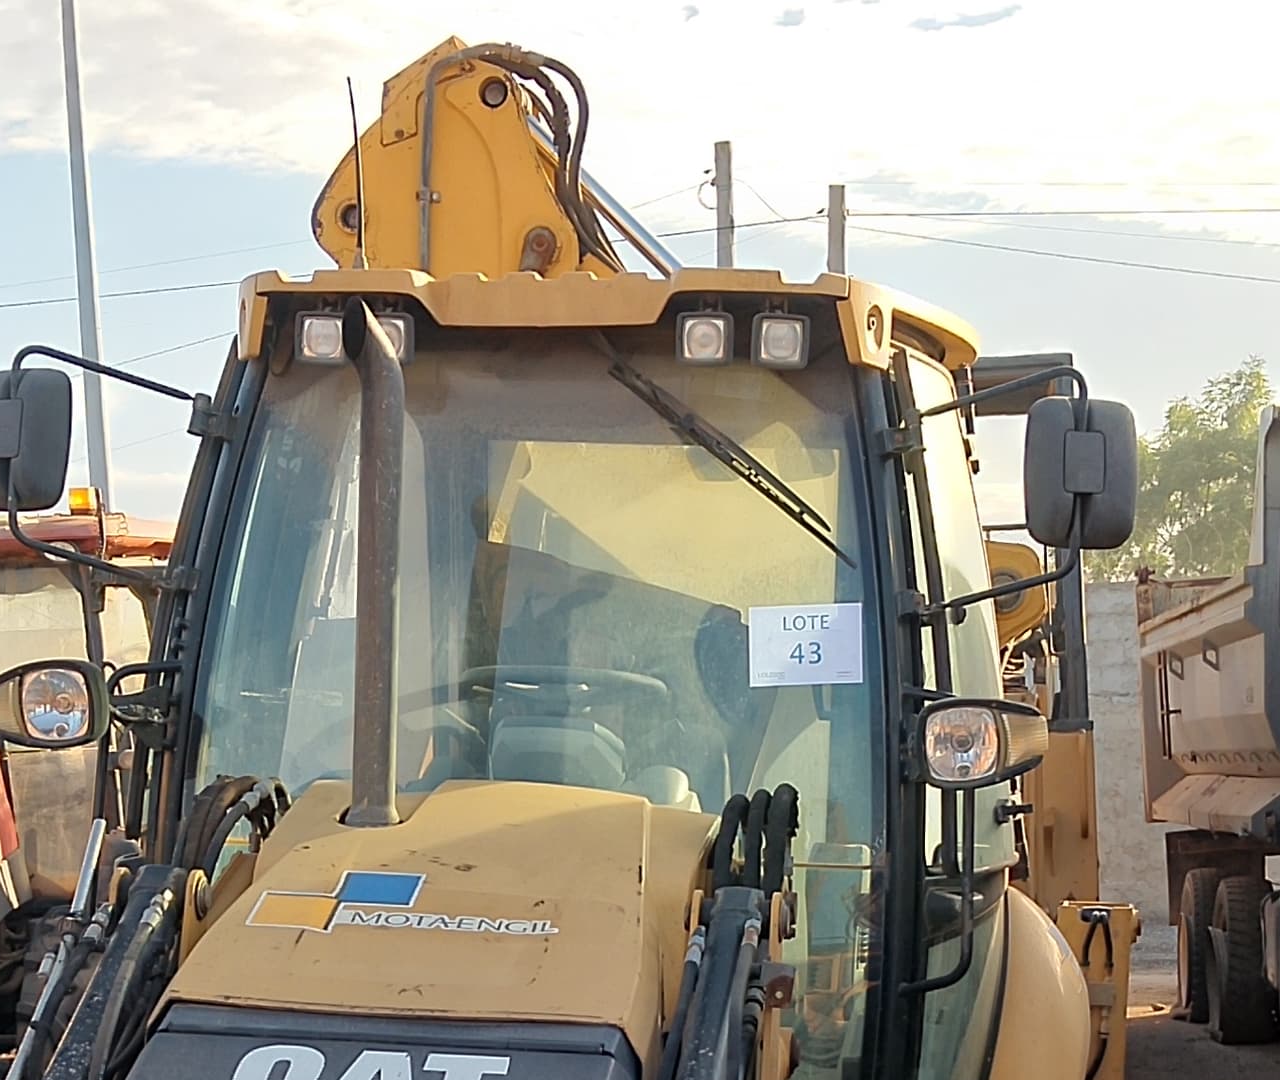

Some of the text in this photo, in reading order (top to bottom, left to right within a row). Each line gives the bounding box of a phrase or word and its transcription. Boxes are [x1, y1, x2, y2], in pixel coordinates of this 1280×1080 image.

[782, 614, 831, 632] LOTE
[789, 641, 823, 665] 43
[350, 910, 559, 934] MOTA-ENGIL
